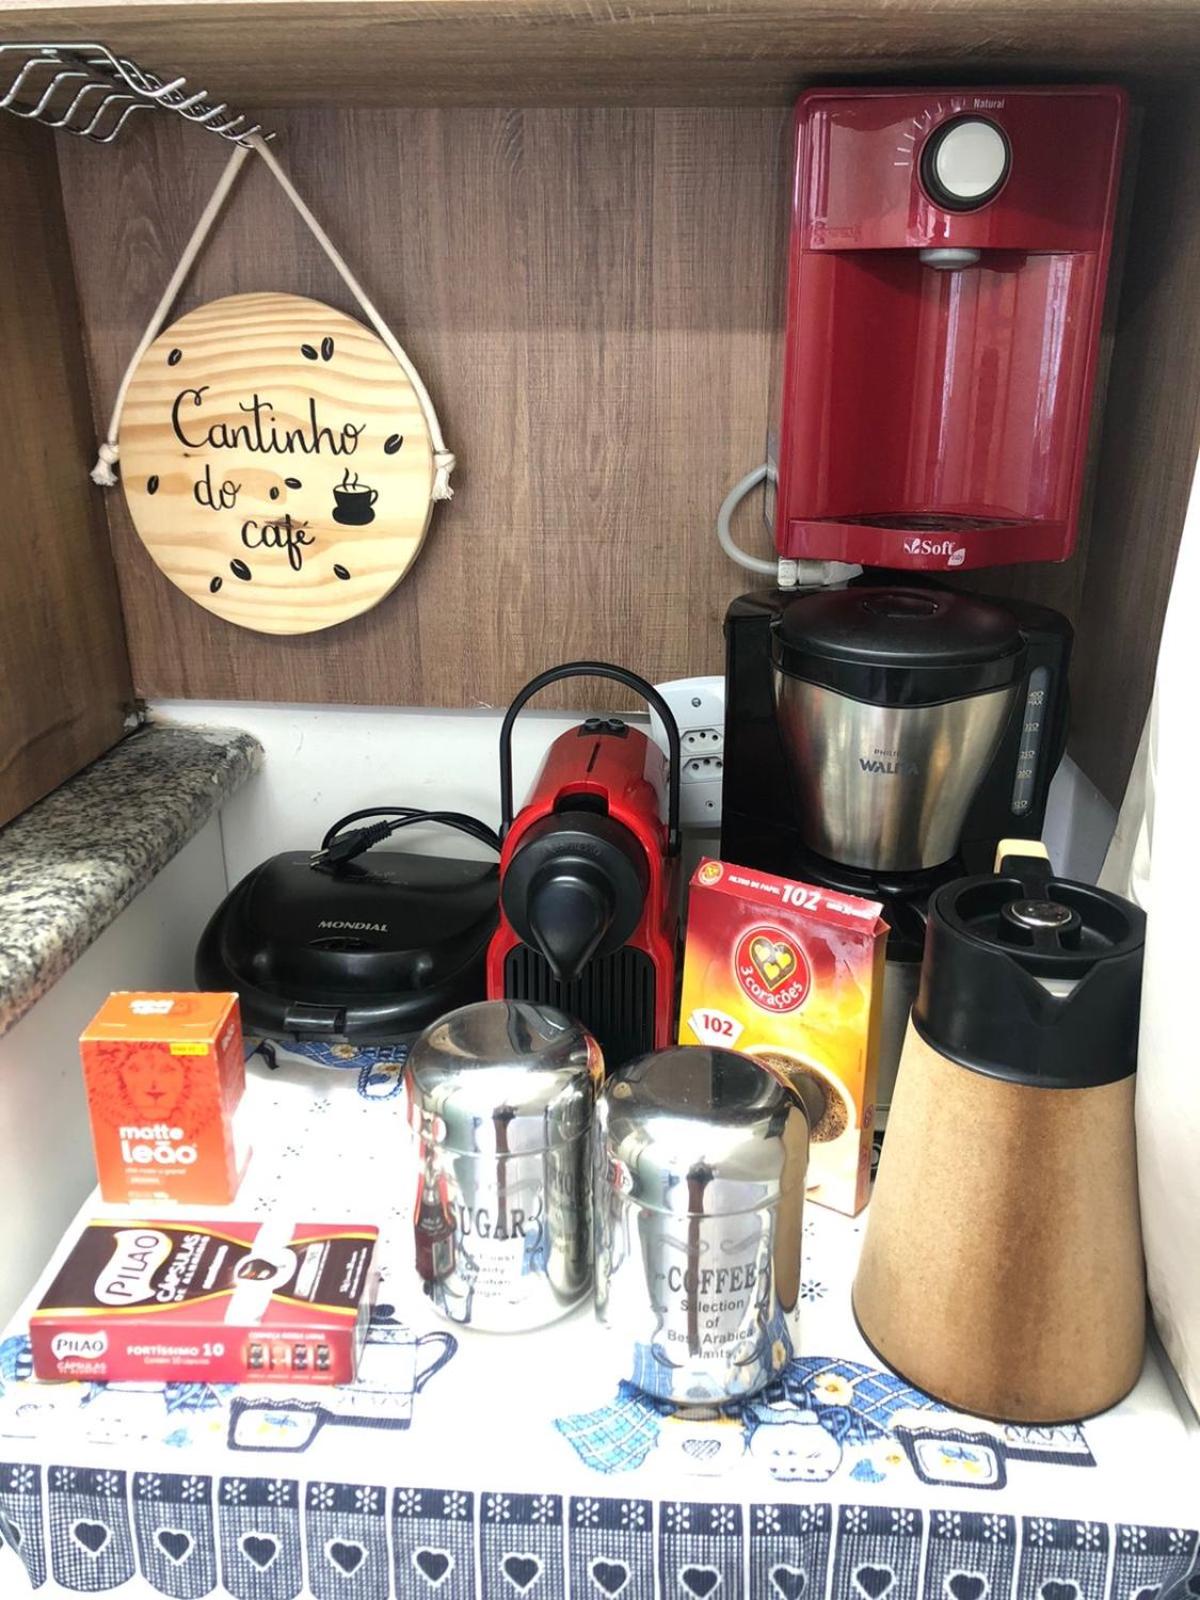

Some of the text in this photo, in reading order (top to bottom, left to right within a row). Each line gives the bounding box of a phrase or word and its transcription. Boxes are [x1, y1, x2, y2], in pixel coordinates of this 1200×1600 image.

[972, 98, 1005, 109] Natural
[172, 386, 366, 455] Cantinho
[194, 464, 241, 511] do
[241, 514, 315, 571] café
[921, 540, 955, 555] Soft
[781, 884, 822, 911] 102
[318, 920, 389, 932] MONDIAL
[740, 965, 803, 1008] 3 corações
[703, 1014, 733, 1037] 102
[121, 1140, 198, 1165] leão
[680, 1298, 744, 1313] Slection
[705, 1317, 720, 1329] of
[203, 1342, 225, 1356] 10
